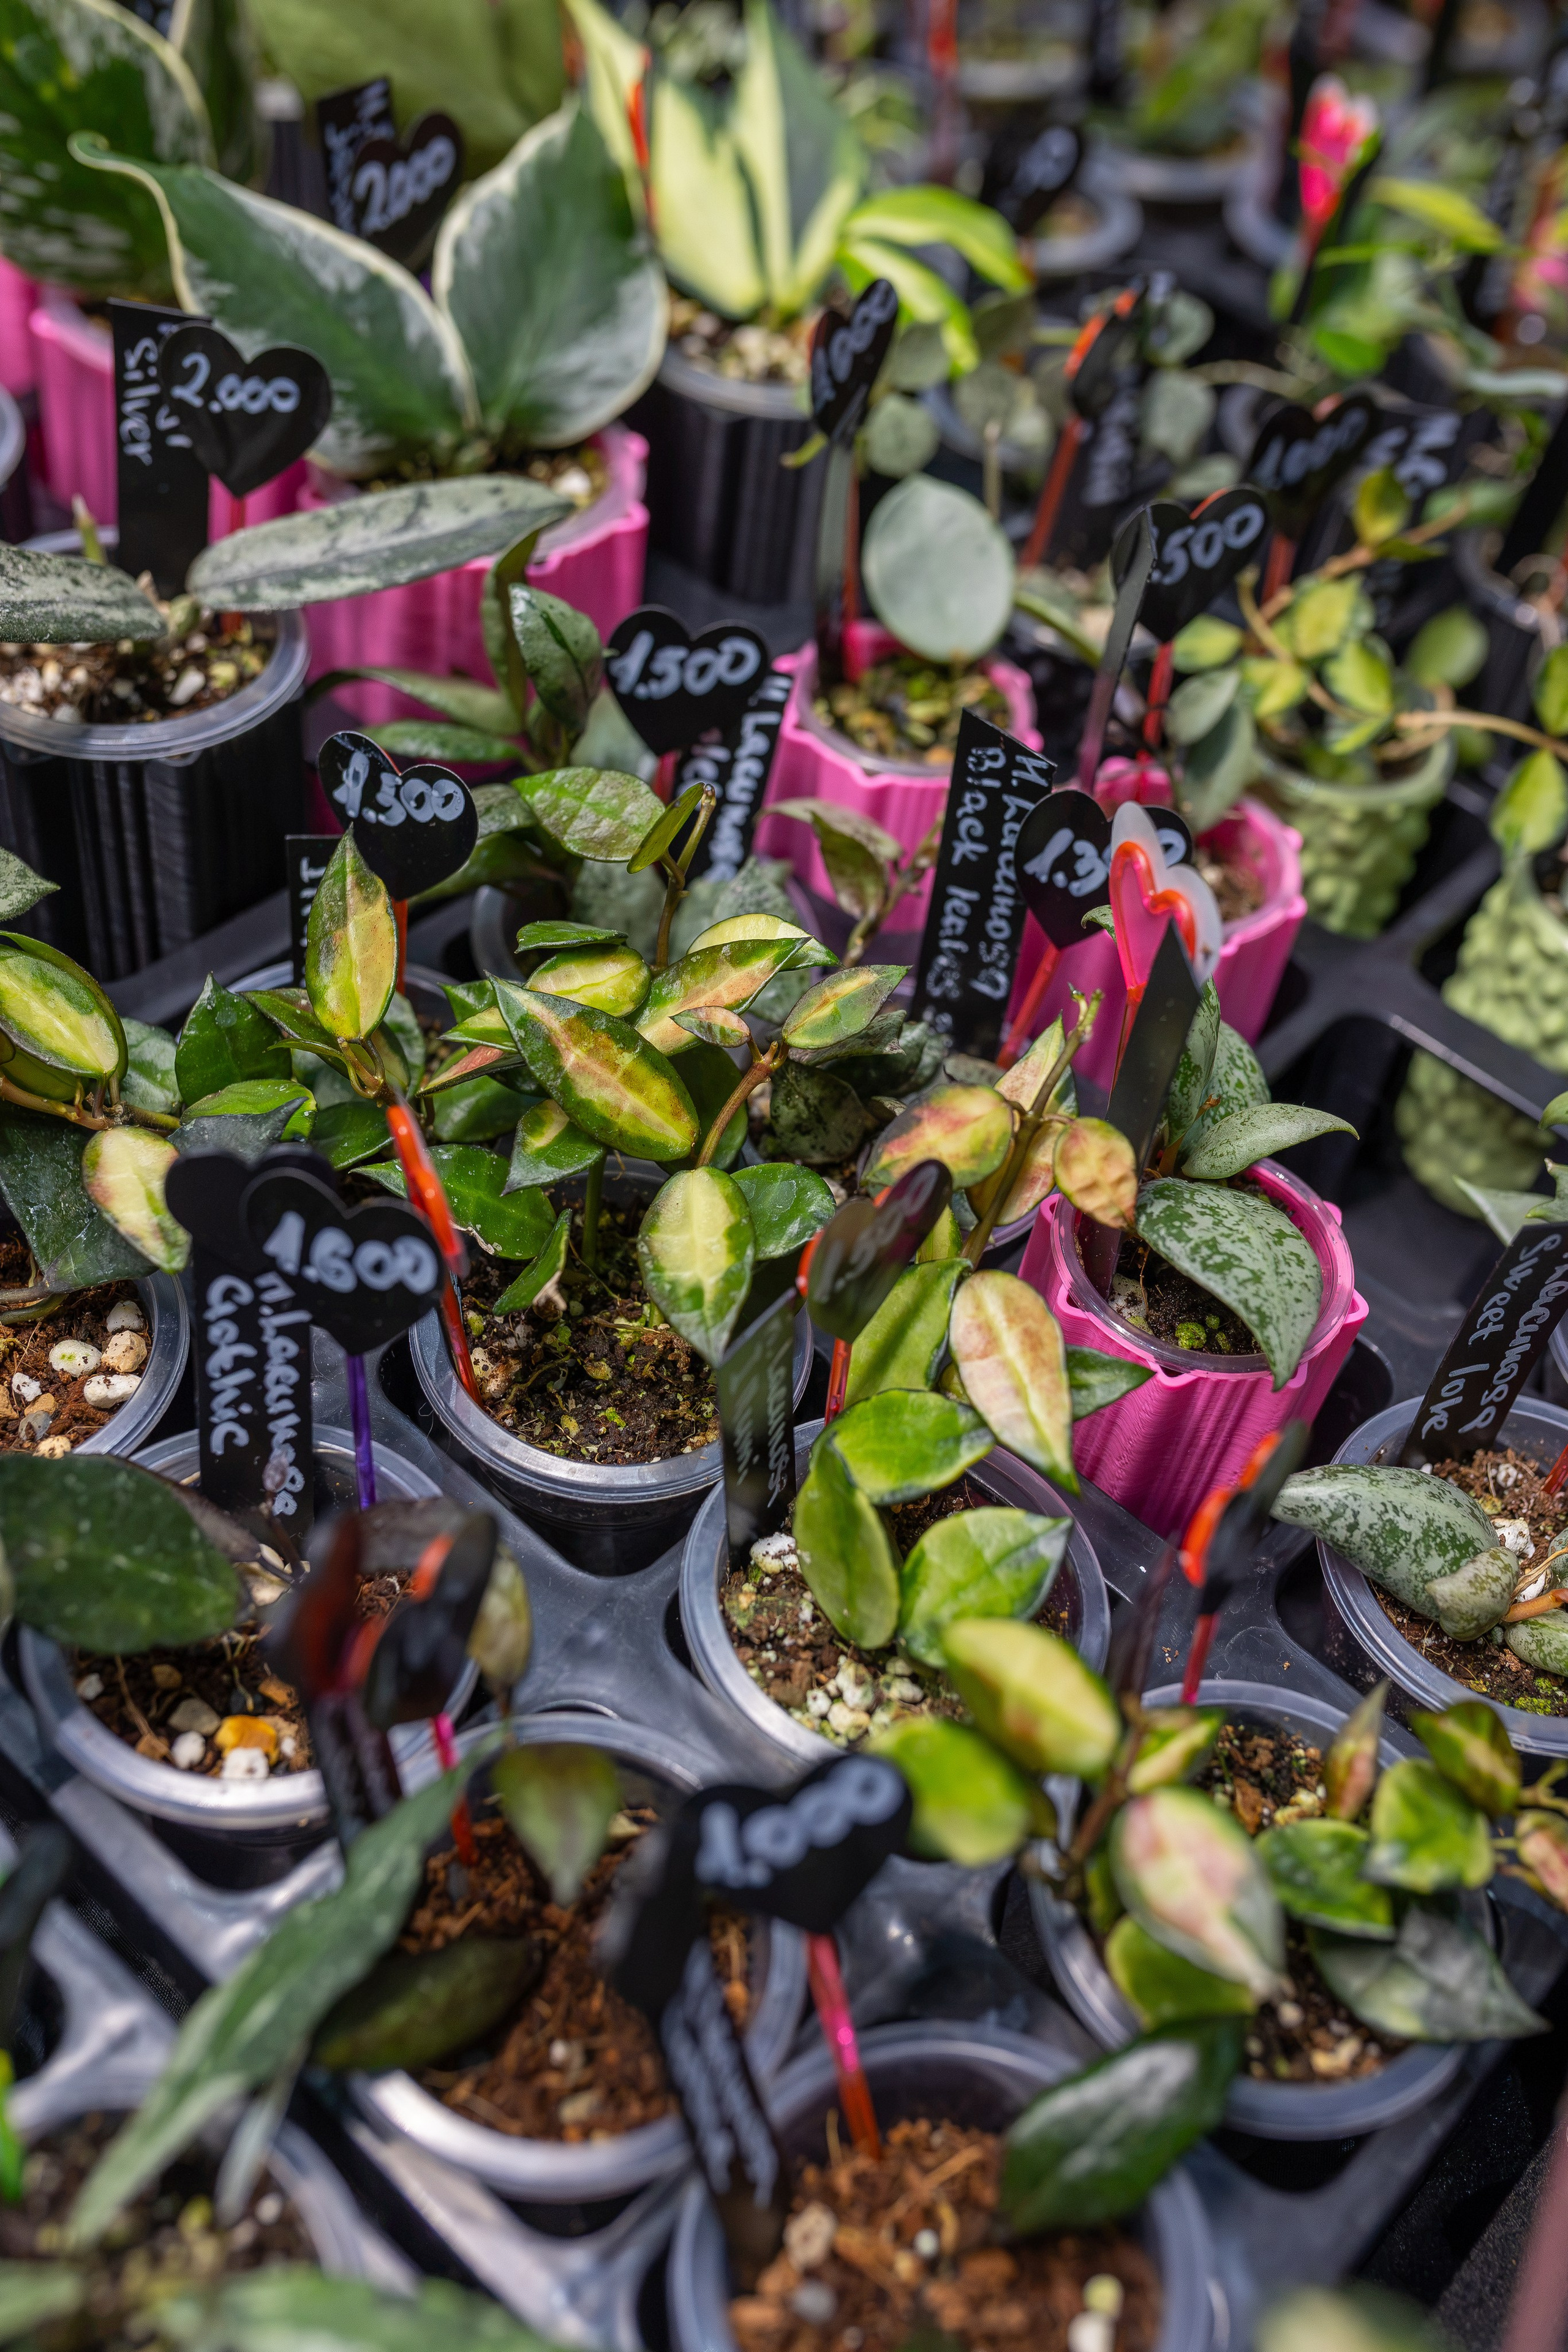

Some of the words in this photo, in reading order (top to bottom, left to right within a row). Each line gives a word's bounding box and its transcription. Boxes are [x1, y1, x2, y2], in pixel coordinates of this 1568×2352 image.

[119, 337, 160, 466] Silver
[172, 353, 300, 414] 2.000
[1148, 503, 1265, 586] .500
[610, 630, 761, 701] 1.500
[333, 751, 466, 827] 1.500
[951, 746, 1007, 866] Black
[1022, 827, 1187, 898] 1.30
[263, 1210, 439, 1295] 1.600
[1467, 1233, 1562, 1346] Sweet
[203, 1274, 258, 1457] Gothic
[1422, 1363, 1490, 1440] love
[695, 1755, 905, 1890] 1.000
